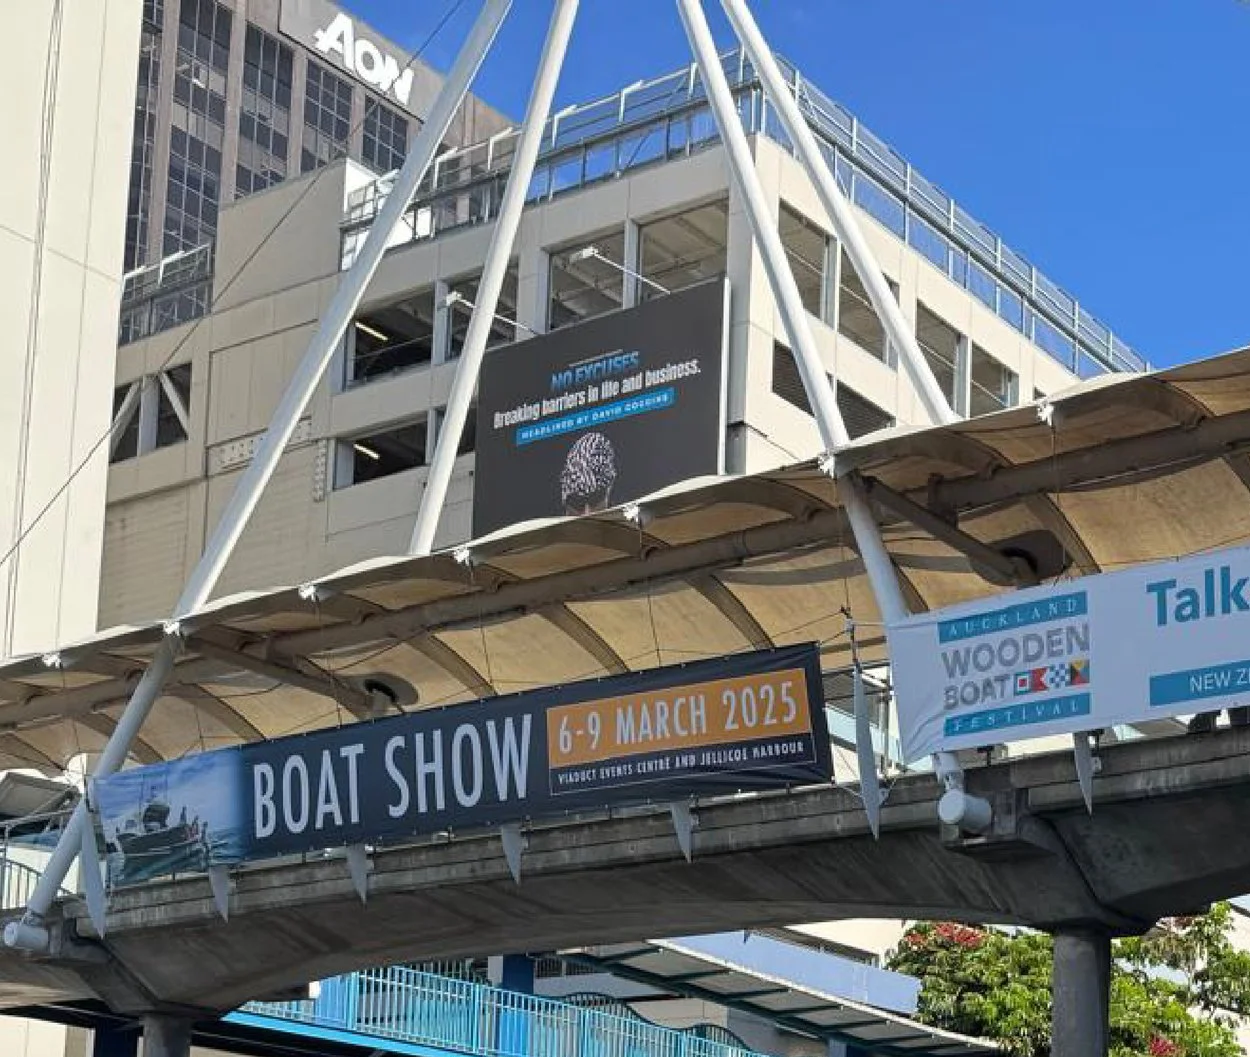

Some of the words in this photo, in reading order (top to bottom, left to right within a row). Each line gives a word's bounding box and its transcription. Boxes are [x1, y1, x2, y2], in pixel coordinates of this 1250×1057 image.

[314, 12, 414, 106] AON
[494, 402, 541, 429] Breaking
[542, 387, 586, 415] barriers
[588, 384, 599, 402] in
[622, 372, 642, 393] and
[645, 358, 701, 385] business.
[949, 599, 1078, 634] AUCKLAND
[942, 624, 1089, 679] WOODEN
[944, 674, 1010, 711] BOAT
[1189, 670, 1232, 693] NEW
[559, 711, 600, 755] 6-9
[616, 693, 706, 745] MARCH
[723, 681, 796, 731] 2025
[953, 700, 1080, 731] FESTIVAL
[254, 743, 364, 840] BOAT
[385, 713, 533, 819] SHOW
[558, 769, 597, 785] VIADUCT
[601, 764, 633, 780] EVENTS
[637, 757, 670, 773] CENTRE
[675, 754, 696, 768] AND
[700, 750, 748, 766] JELLICOE
[752, 741, 804, 758] HARBOUR
